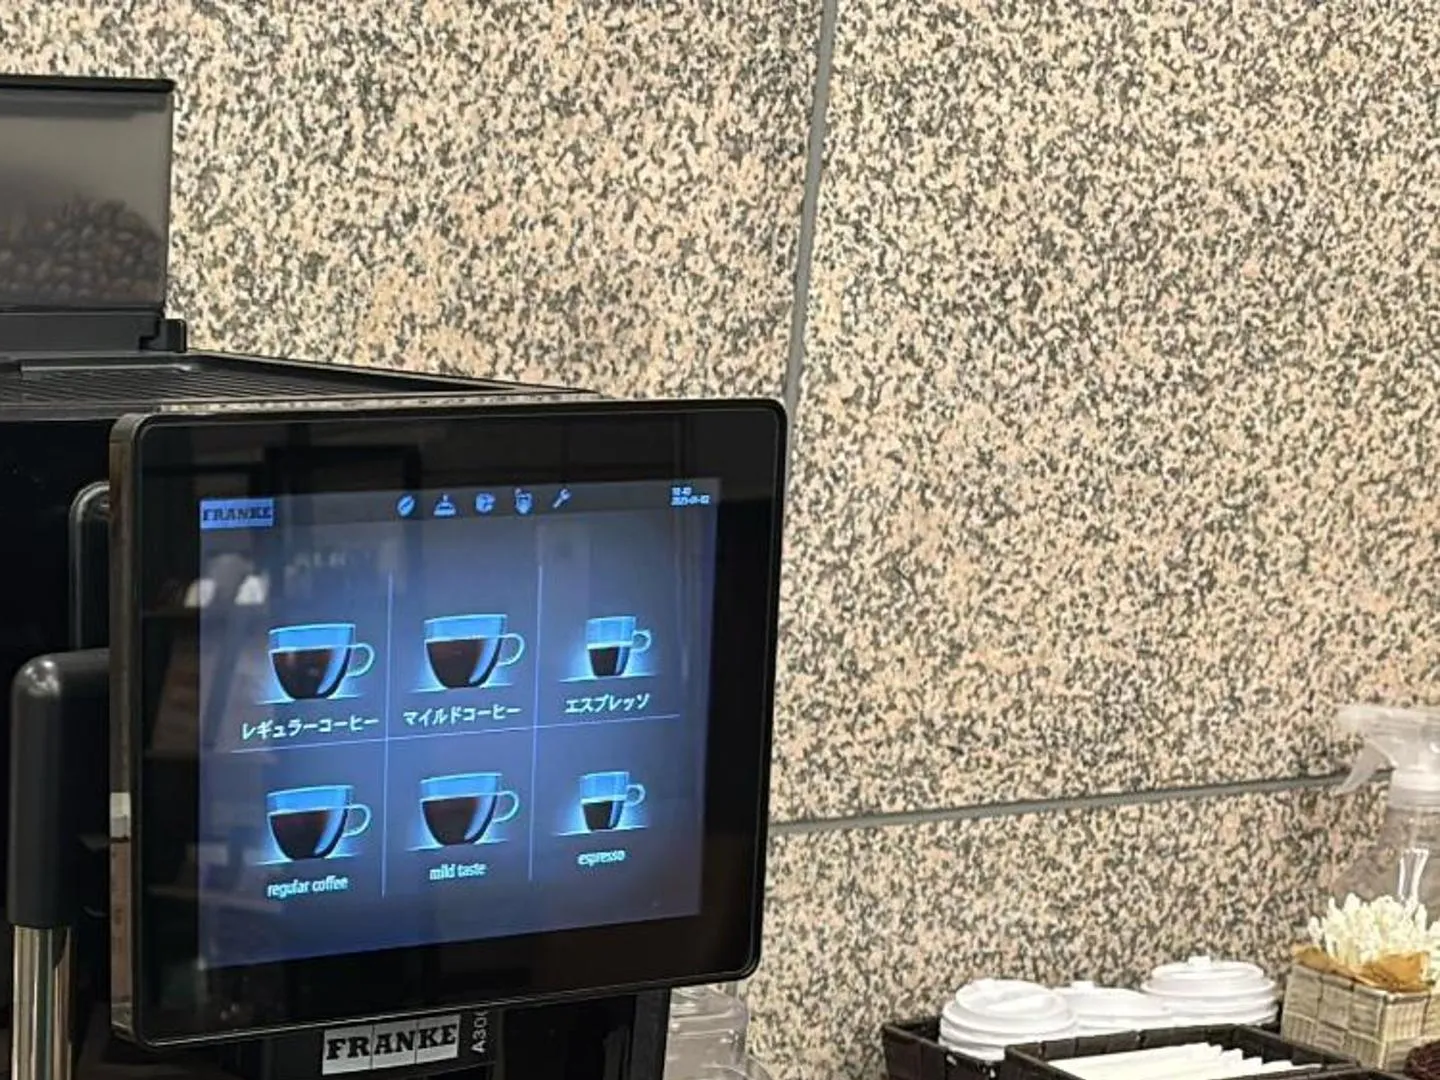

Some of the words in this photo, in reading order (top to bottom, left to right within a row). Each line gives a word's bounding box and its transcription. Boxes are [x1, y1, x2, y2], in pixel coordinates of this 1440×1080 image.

[403, 703, 522, 727] マイルドコーヒー
[565, 693, 651, 714] エスプレッソ
[242, 714, 380, 740] レギュラーコーヒー
[577, 849, 626, 867] espresso
[429, 863, 455, 880] mild
[457, 861, 487, 878] taste
[267, 878, 310, 899] regular
[312, 875, 348, 893] coffee
[326, 1023, 458, 1061] FRANKE
